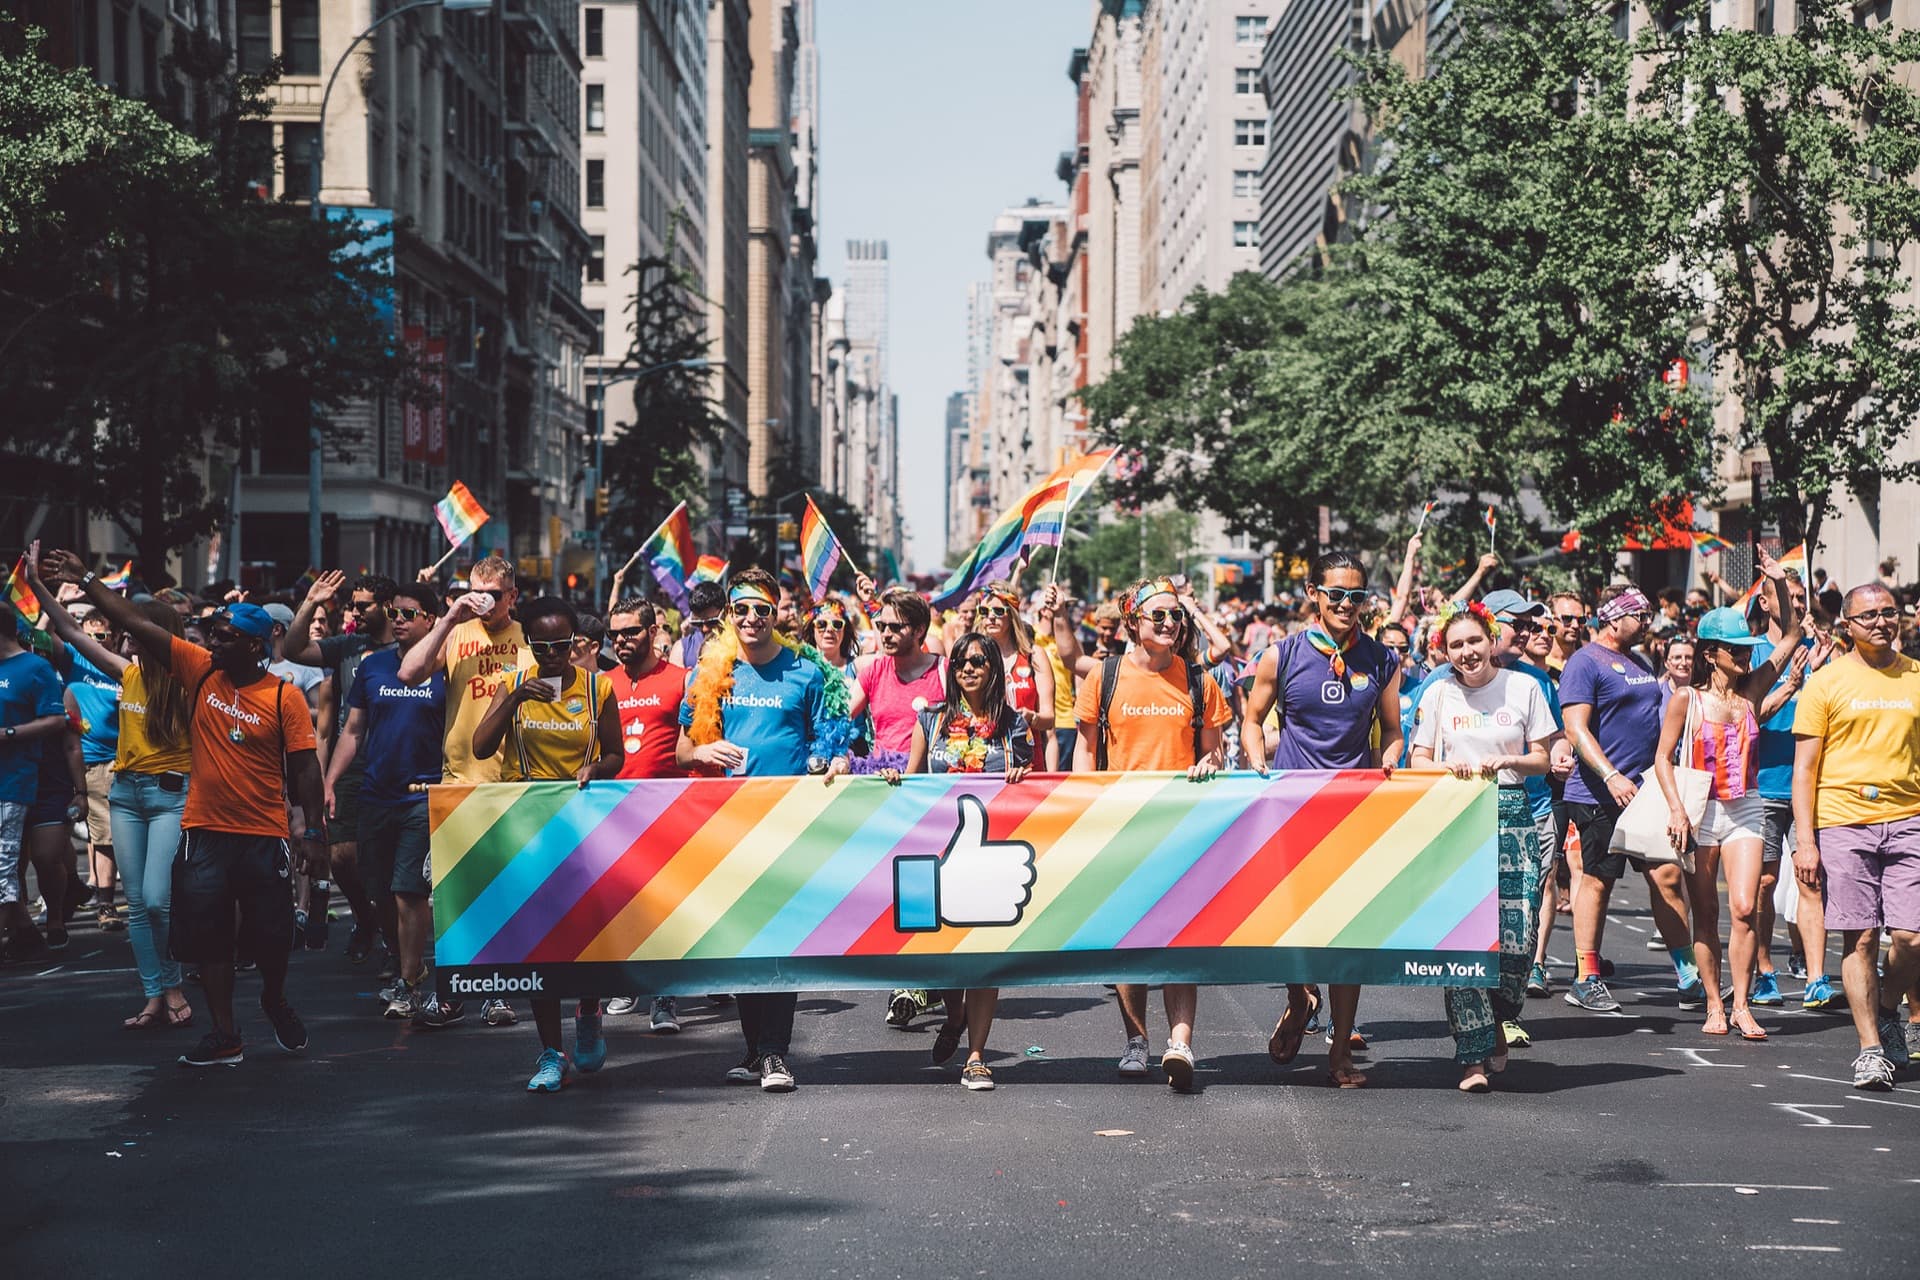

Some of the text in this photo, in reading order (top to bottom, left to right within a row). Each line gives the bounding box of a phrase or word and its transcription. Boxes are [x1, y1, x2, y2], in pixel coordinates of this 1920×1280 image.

[458, 638, 518, 658] Where's
[478, 659, 503, 676] the
[379, 685, 433, 699] facebook
[206, 692, 260, 725] facebook
[618, 694, 661, 709] cebook
[1121, 702, 1185, 716] facebook
[1851, 697, 1914, 711] facebook
[523, 717, 583, 731] facebook
[1453, 712, 1489, 731] PRIDE
[1405, 961, 1487, 977] New York
[449, 971, 544, 993] facebook
